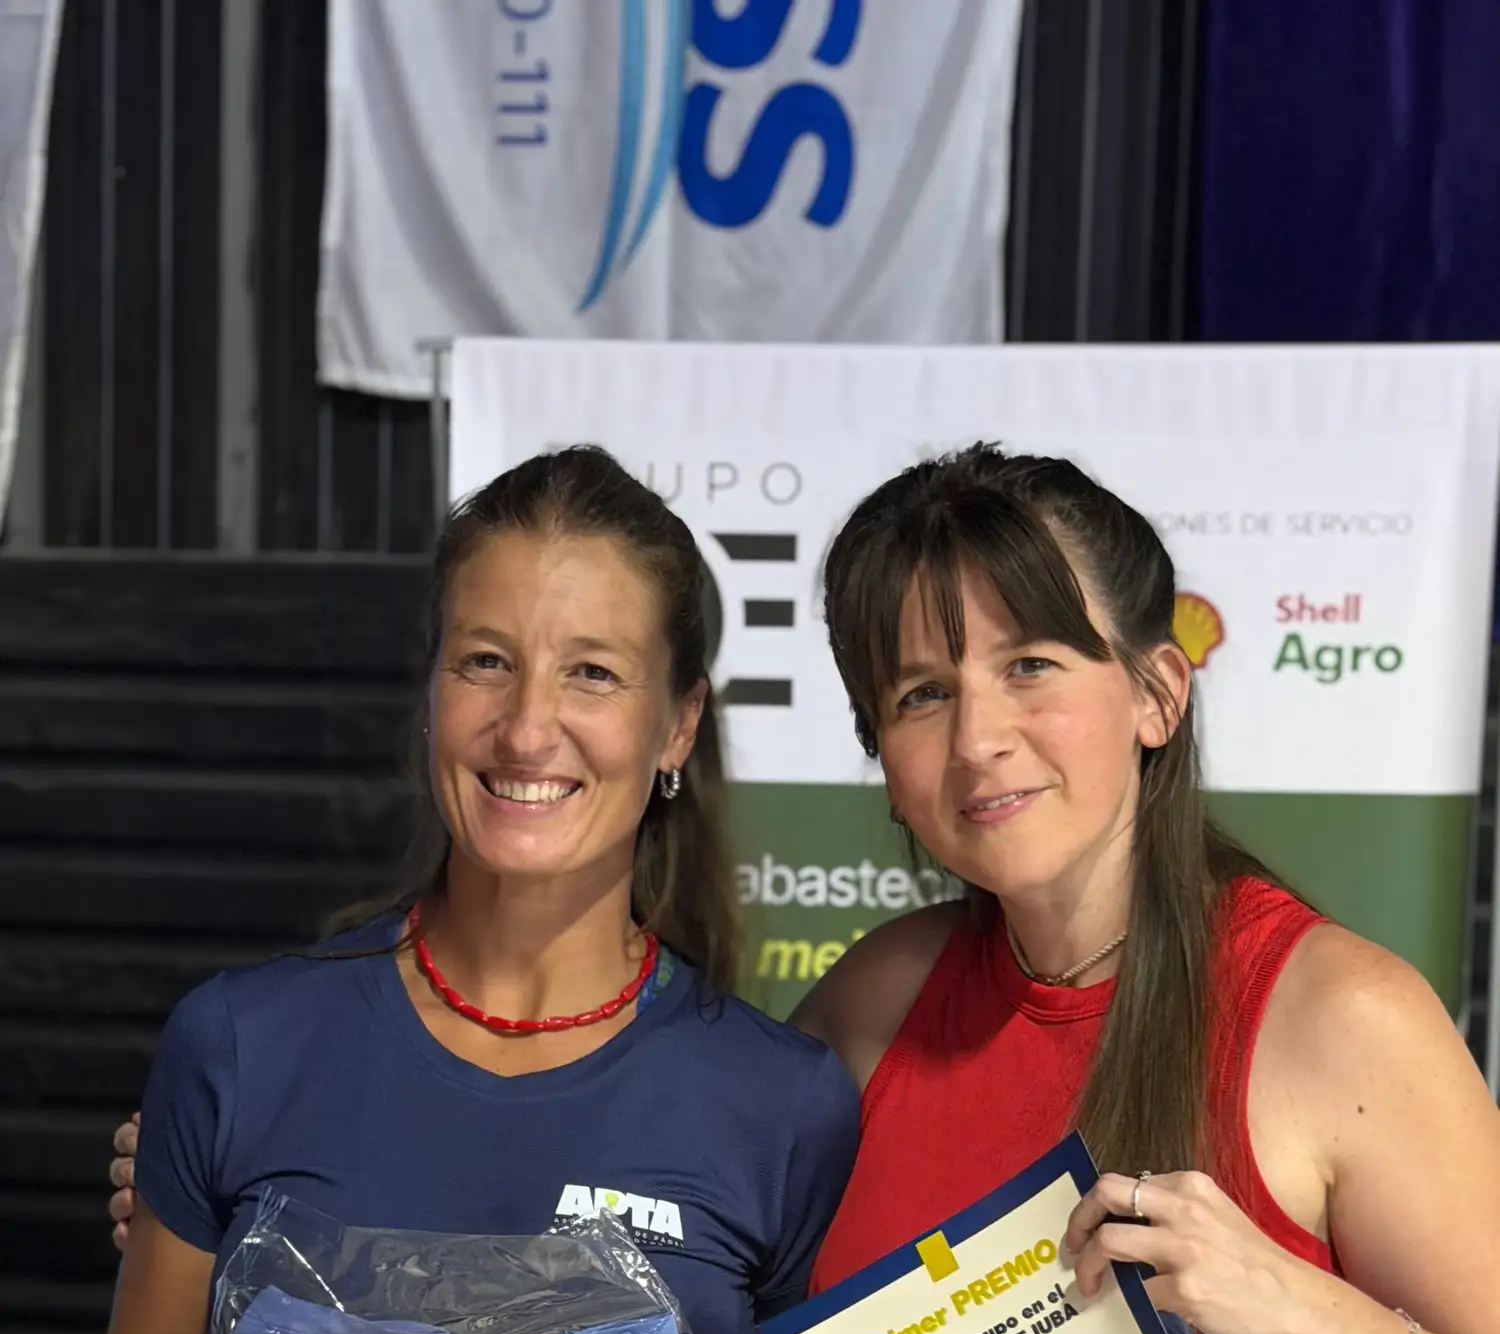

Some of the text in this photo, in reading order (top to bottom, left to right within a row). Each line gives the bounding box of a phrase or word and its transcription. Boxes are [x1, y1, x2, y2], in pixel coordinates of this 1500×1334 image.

[648, 461, 803, 507] UPO
[1152, 510, 1414, 536] ONES DE SERVICIO
[1275, 594, 1362, 623] Shell
[1272, 632, 1405, 685] Agro
[555, 1183, 684, 1241] APTA
[950, 1238, 1058, 1316] PREMIO
[1021, 1300, 1046, 1319] en
[1047, 1283, 1066, 1304] el
